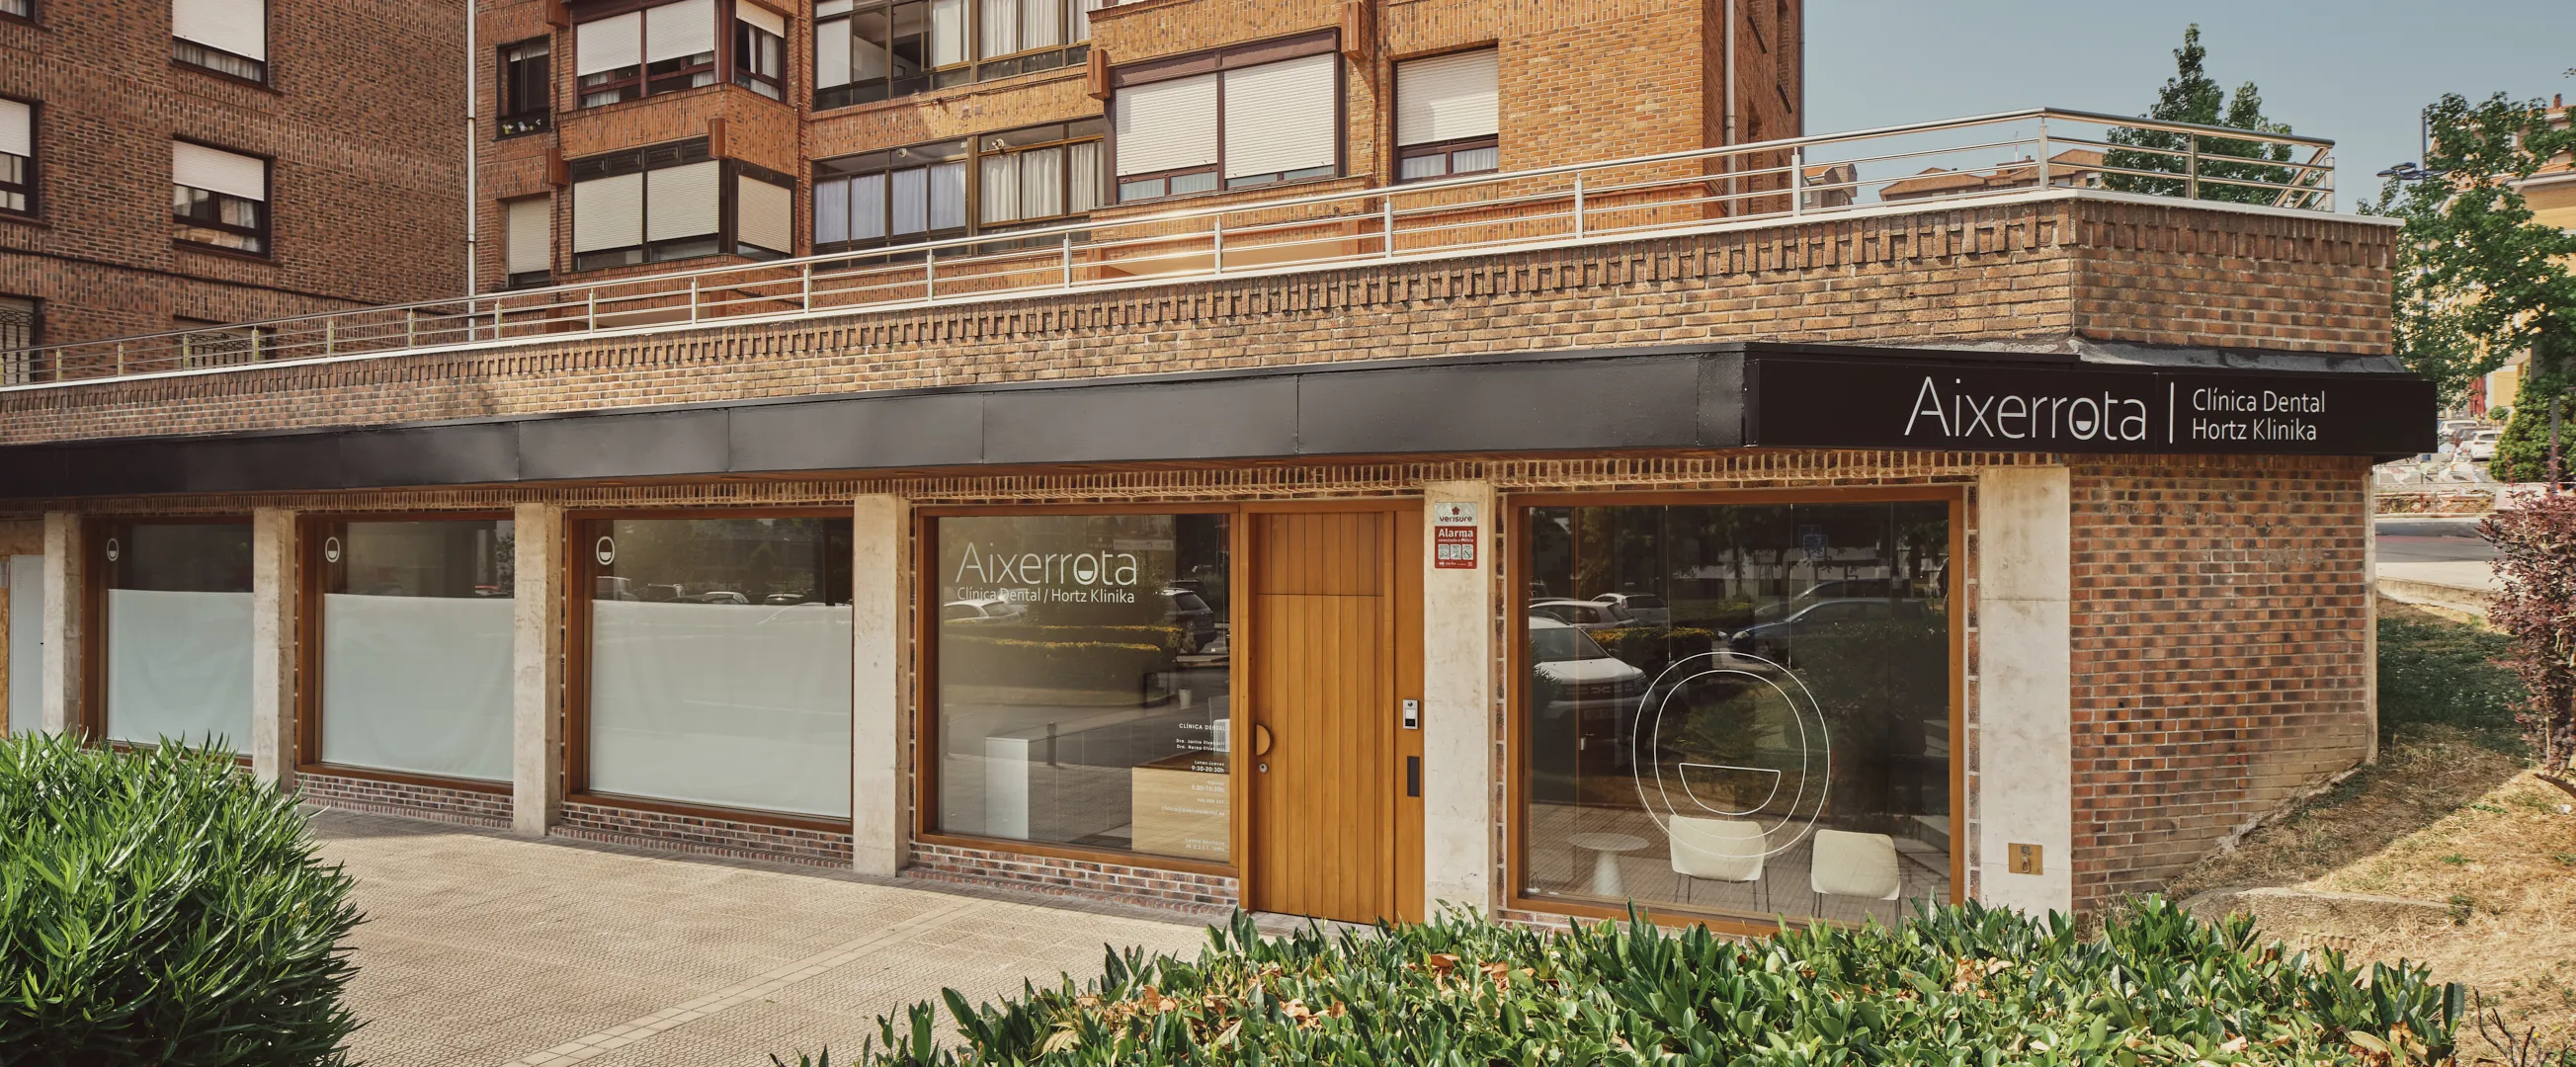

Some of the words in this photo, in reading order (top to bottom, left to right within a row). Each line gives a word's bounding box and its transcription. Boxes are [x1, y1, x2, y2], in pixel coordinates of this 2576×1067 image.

[1904, 376, 2147, 442] Aixerrota
[2193, 388, 2258, 412] Clínica
[2263, 390, 2326, 414] Dental
[2192, 418, 2248, 441] Hortz
[2253, 419, 2317, 442] Klinika
[1439, 528, 1473, 537] Alarma
[956, 542, 1137, 586] Aixerrota
[956, 586, 997, 601] Clínica
[999, 588, 1041, 602] Dental
[1050, 588, 1088, 603] Hortz
[1090, 589, 1135, 604] Klinika
